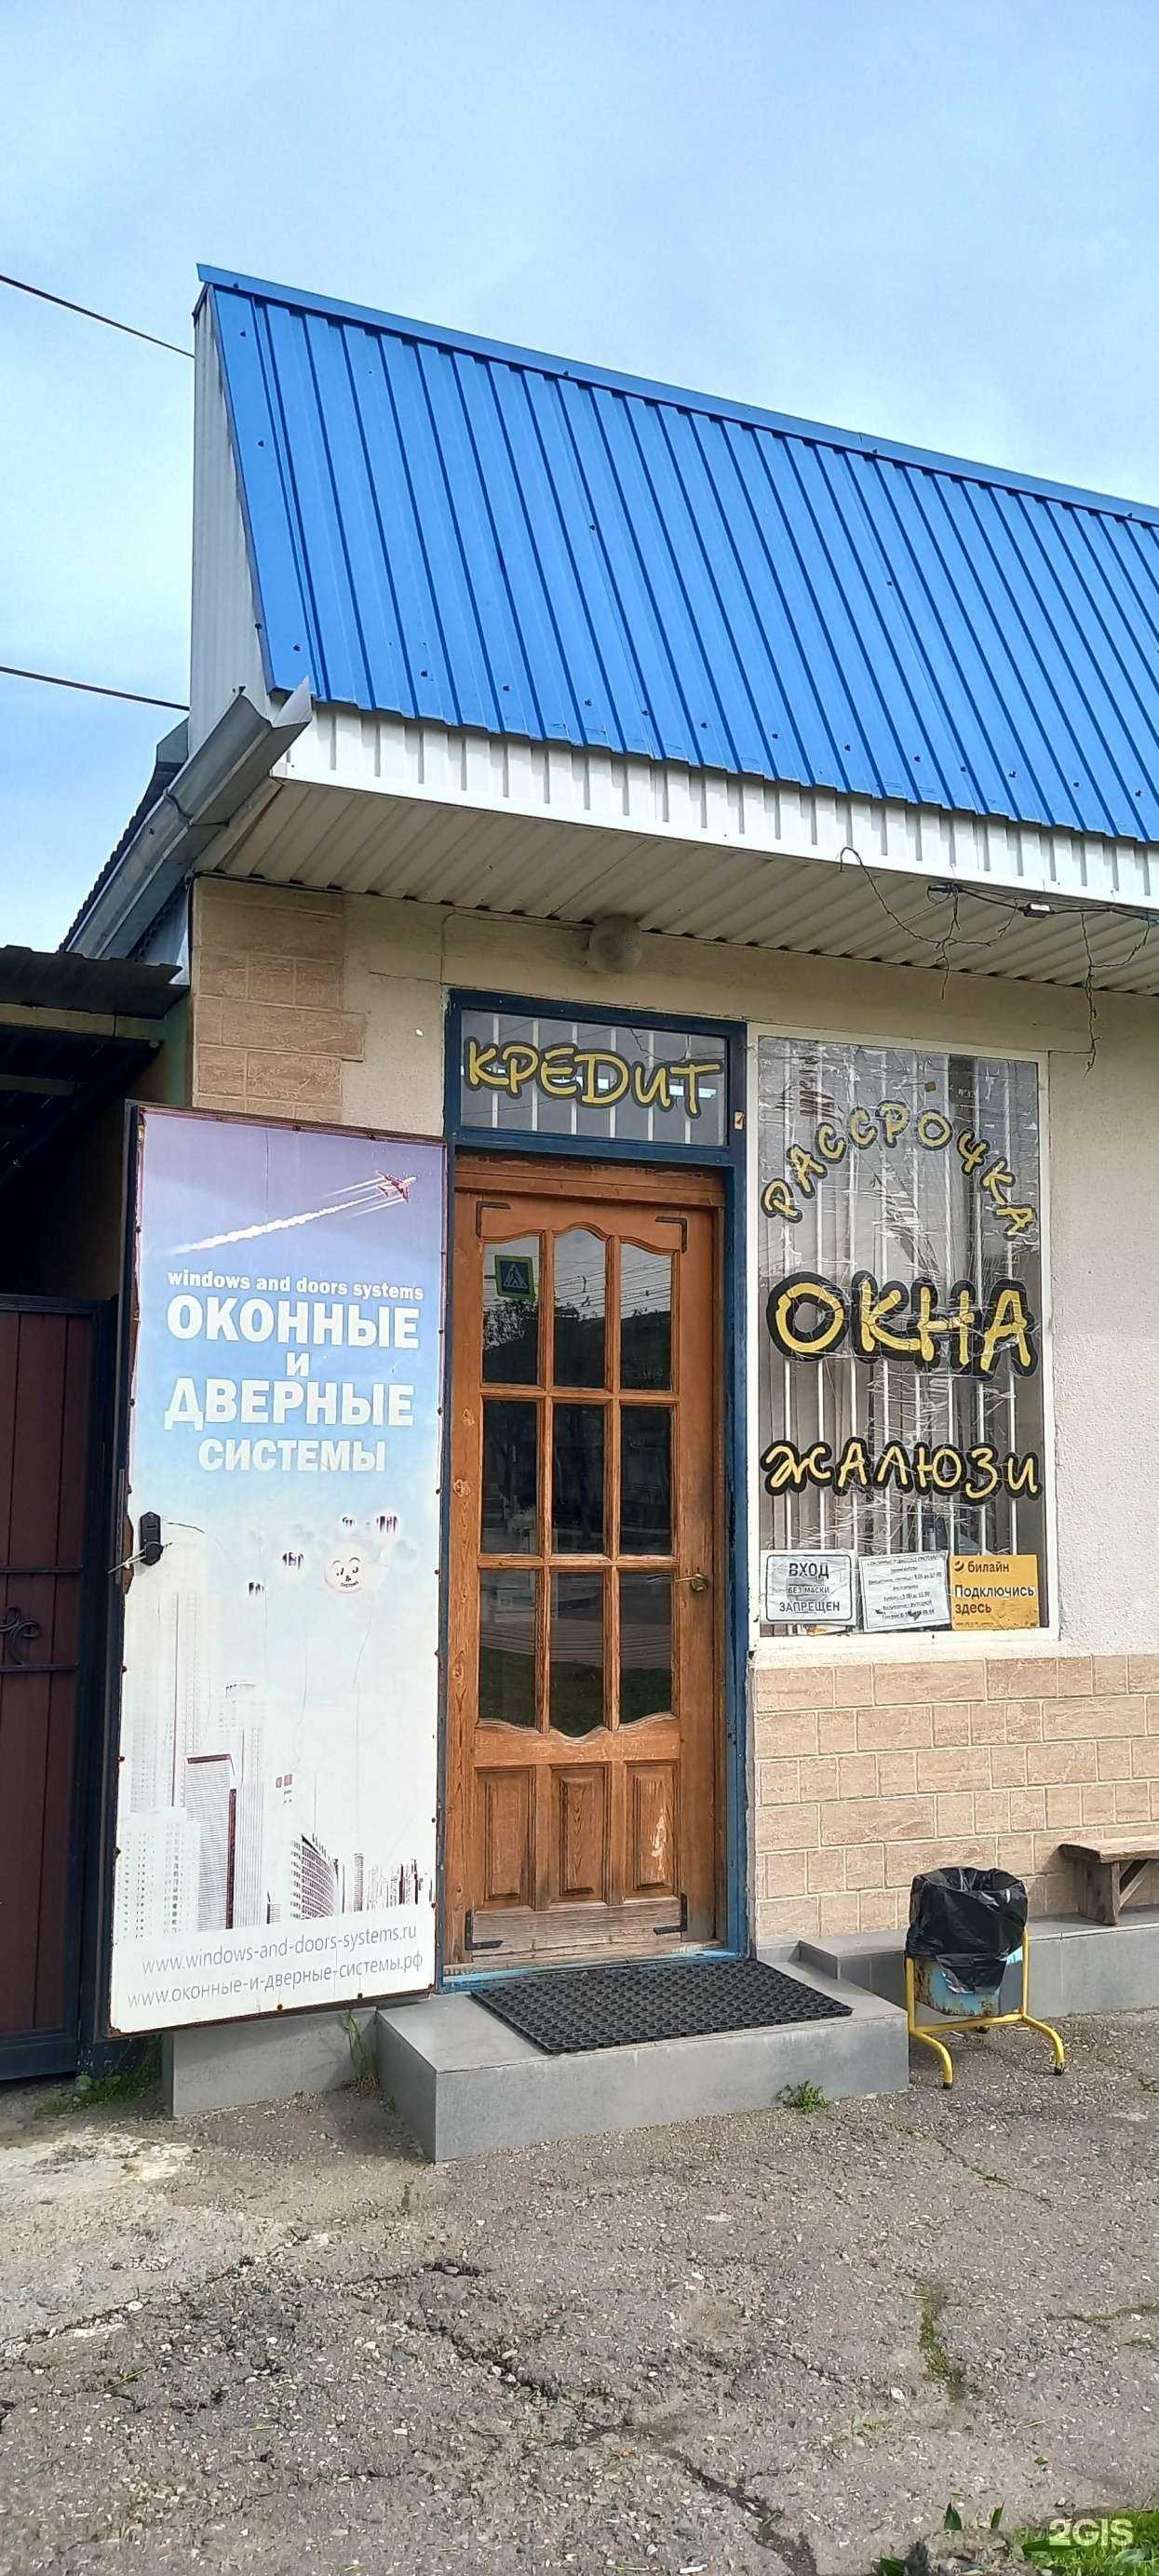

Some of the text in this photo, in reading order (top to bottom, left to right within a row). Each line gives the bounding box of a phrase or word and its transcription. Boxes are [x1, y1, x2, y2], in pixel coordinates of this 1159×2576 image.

[465, 1037, 724, 1119] КРЕДИТ
[761, 1099, 1038, 1241] РАССРОЧКА
[168, 1269, 425, 1301] windows and doors systems
[166, 1294, 421, 1349] ОКОННЫЕ
[767, 1272, 1037, 1380] ОКНА
[164, 1377, 415, 1431] ДВЕРНЫЕ
[198, 1438, 387, 1472] СИСТЕМЫ
[761, 1436, 1043, 1511] ЖАЛЮЗИ
[788, 1562, 829, 1579] ВХОД
[967, 1561, 1010, 1573] билайн
[778, 1601, 840, 1613] ЗАПРЕЩЕН
[788, 1586, 829, 1594] БЕЗ МАСКИ
[954, 1584, 1034, 1600] Подключись
[954, 1603, 992, 1617] здесь
[142, 1923, 417, 1974] www.windows-and-doors-systems.ru
[128, 1951, 424, 2008] www.оконные-и-дверные-системы.рф
